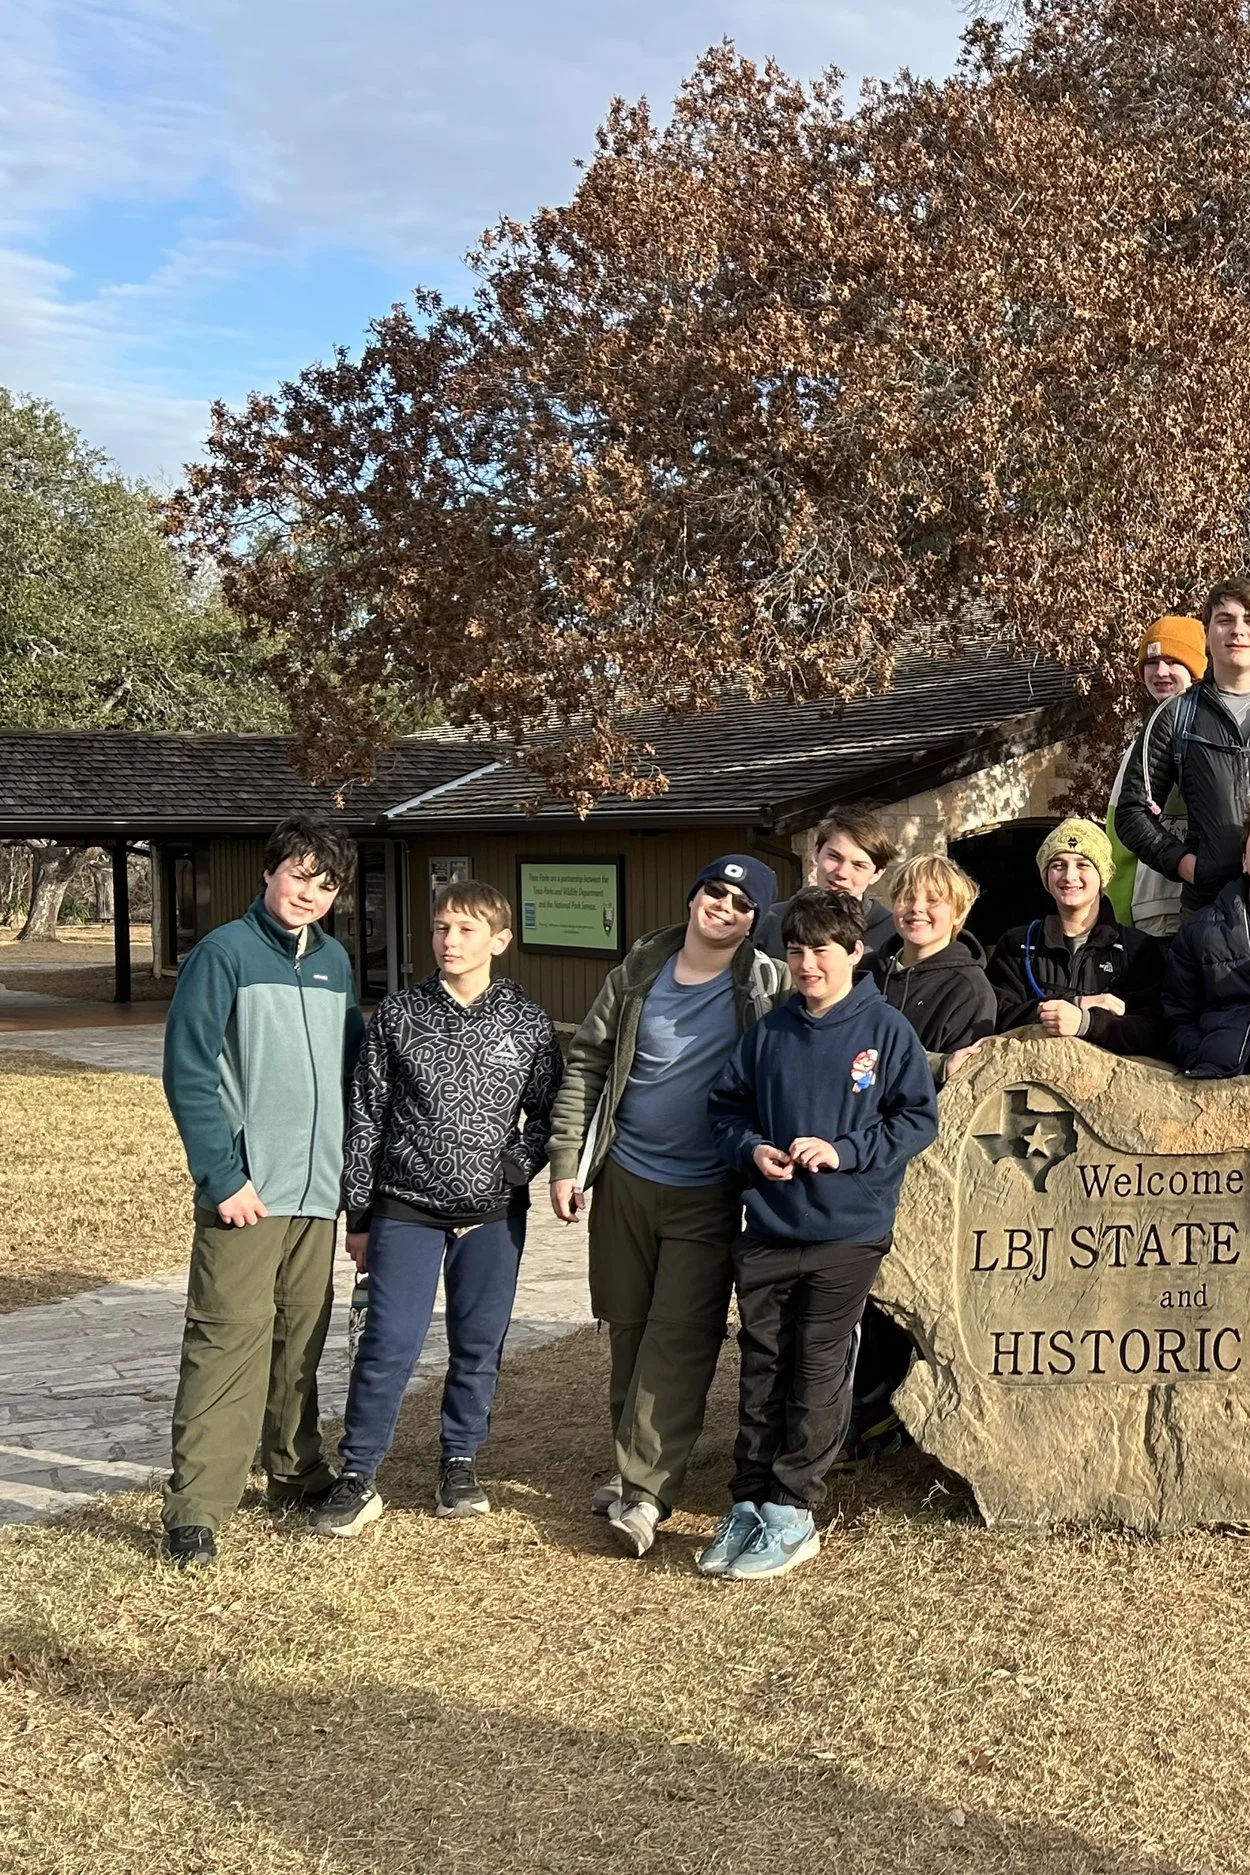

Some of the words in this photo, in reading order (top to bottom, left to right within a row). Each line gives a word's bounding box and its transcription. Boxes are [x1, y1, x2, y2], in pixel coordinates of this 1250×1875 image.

[561, 874, 583, 885] partnership
[584, 873, 600, 884] between
[563, 886, 577, 896] Wildlife
[579, 888, 604, 898] Department
[554, 900, 570, 909] National
[571, 900, 581, 909] Park
[1077, 1163, 1245, 1198] Welcome
[970, 1226, 1056, 1282] LBJ
[1069, 1221, 1241, 1269] STATE
[1160, 1283, 1208, 1309] and
[988, 1327, 1242, 1377] HISTORIC
